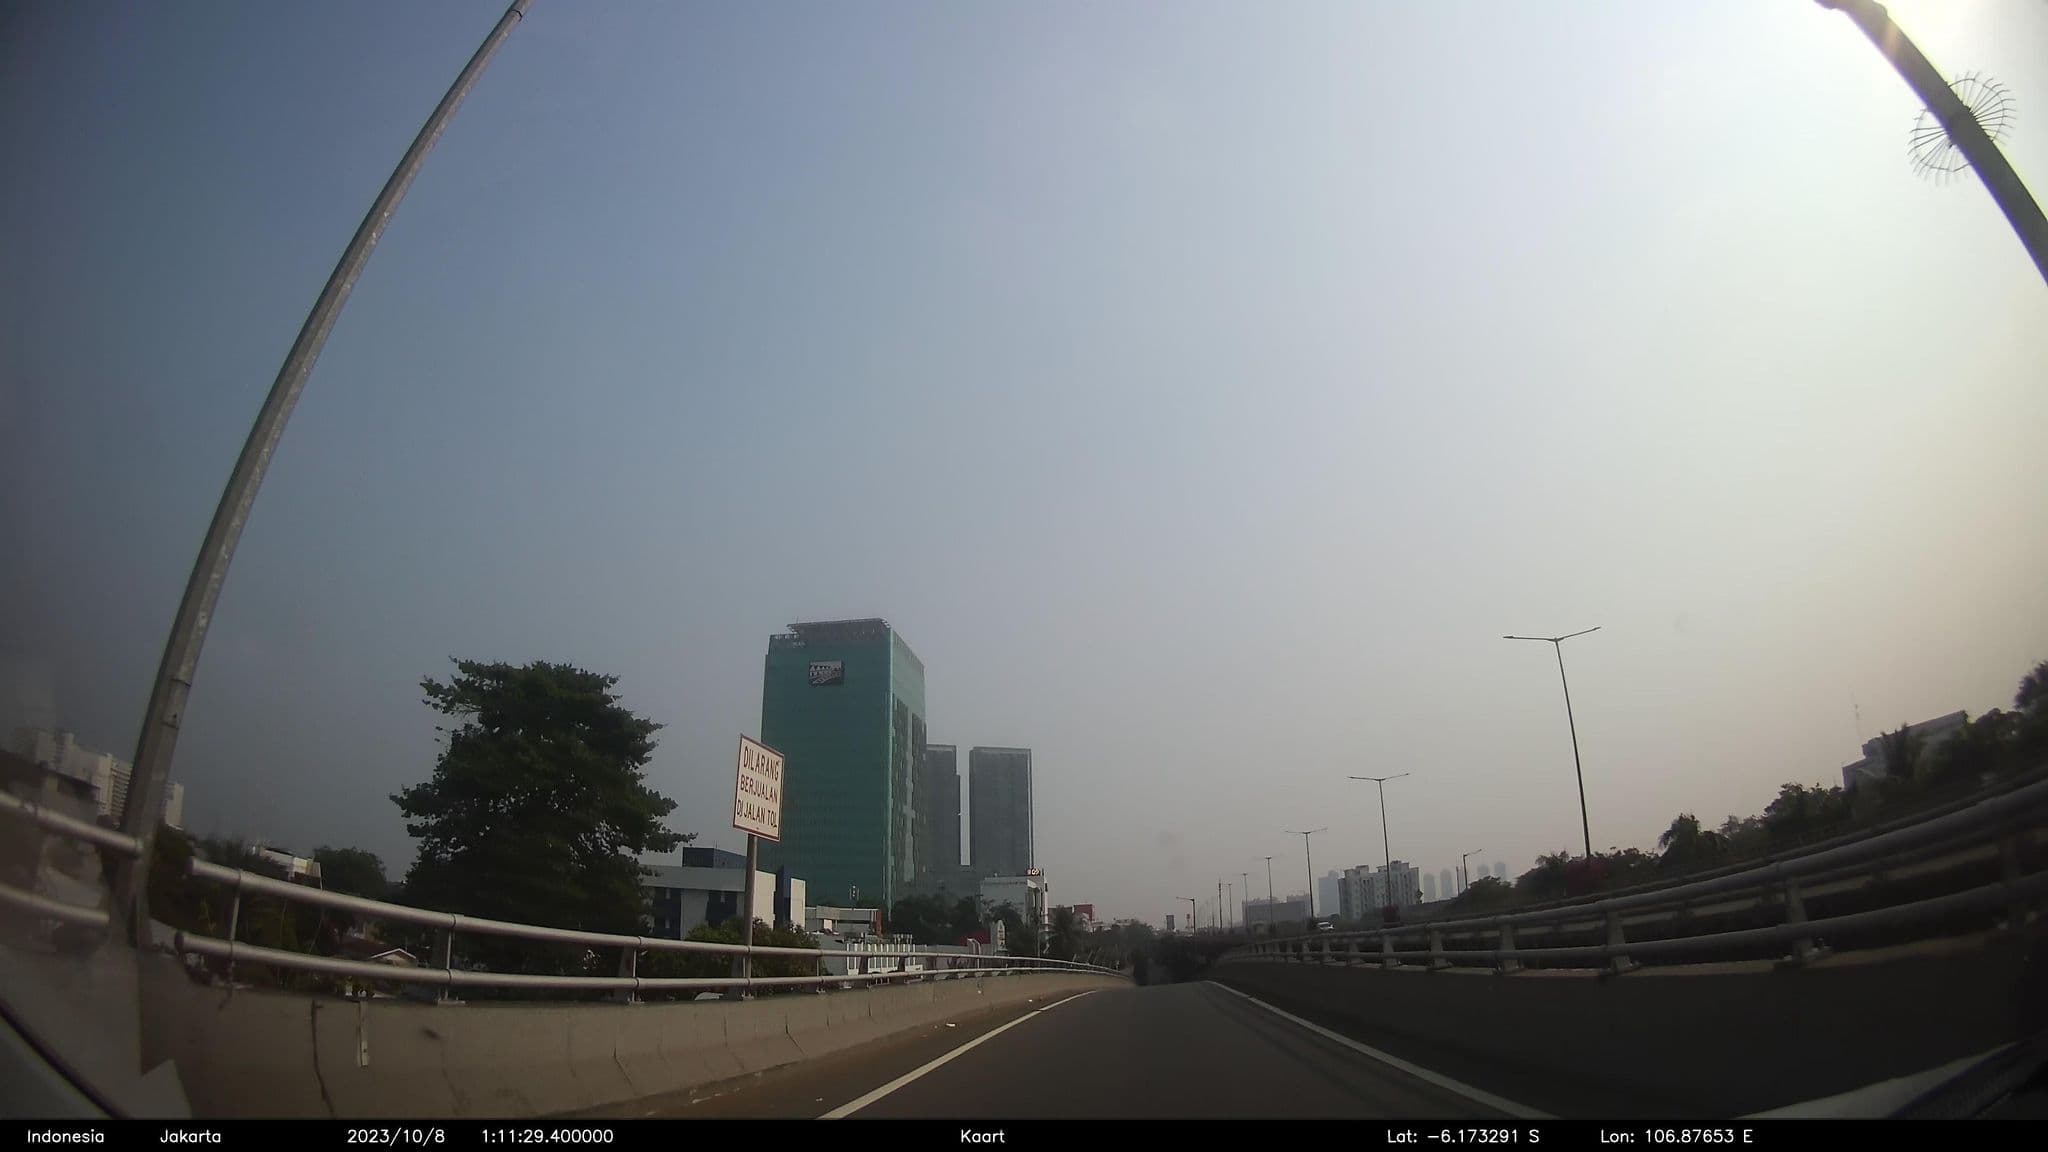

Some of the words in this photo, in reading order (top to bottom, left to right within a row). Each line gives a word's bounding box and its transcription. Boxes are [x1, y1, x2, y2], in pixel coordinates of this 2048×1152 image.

[743, 746, 780, 781] DILARANG
[740, 774, 778, 804] BERJUALAN
[736, 799, 743, 817] DI
[744, 802, 766, 825] JALAN
[767, 809, 778, 828] TOL
